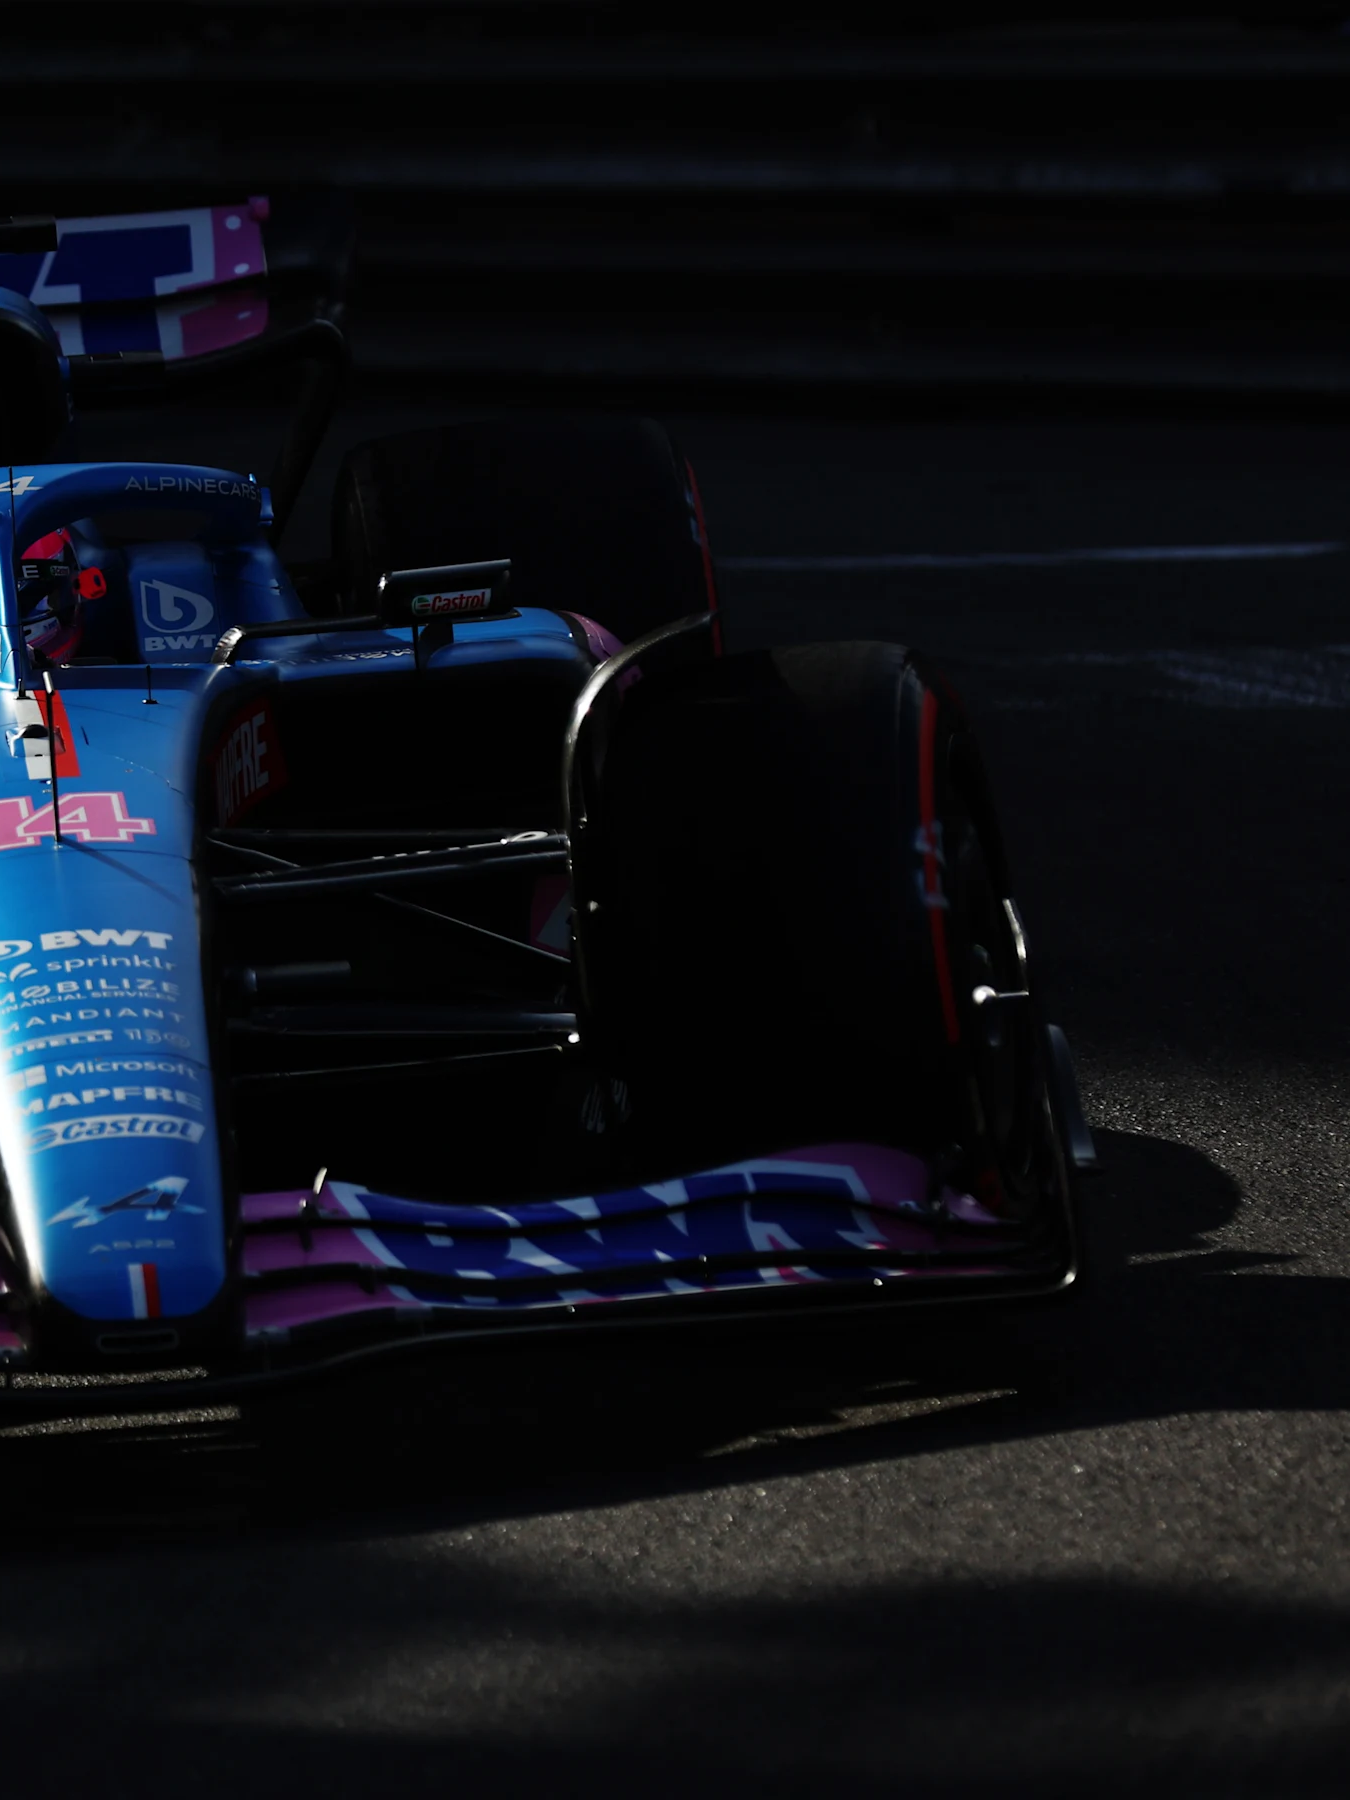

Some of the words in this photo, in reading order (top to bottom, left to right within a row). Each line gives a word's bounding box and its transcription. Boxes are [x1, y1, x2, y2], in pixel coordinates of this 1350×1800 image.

[430, 591, 487, 614] Castrol
[144, 634, 217, 652] BWT
[215, 710, 270, 829] MAPFRE
[40, 929, 173, 951] BWT
[47, 954, 178, 973] sprinklr
[55, 1060, 199, 1081] Microsoft
[16, 1086, 203, 1117] MAPFRE
[60, 1116, 195, 1140] Castrol
